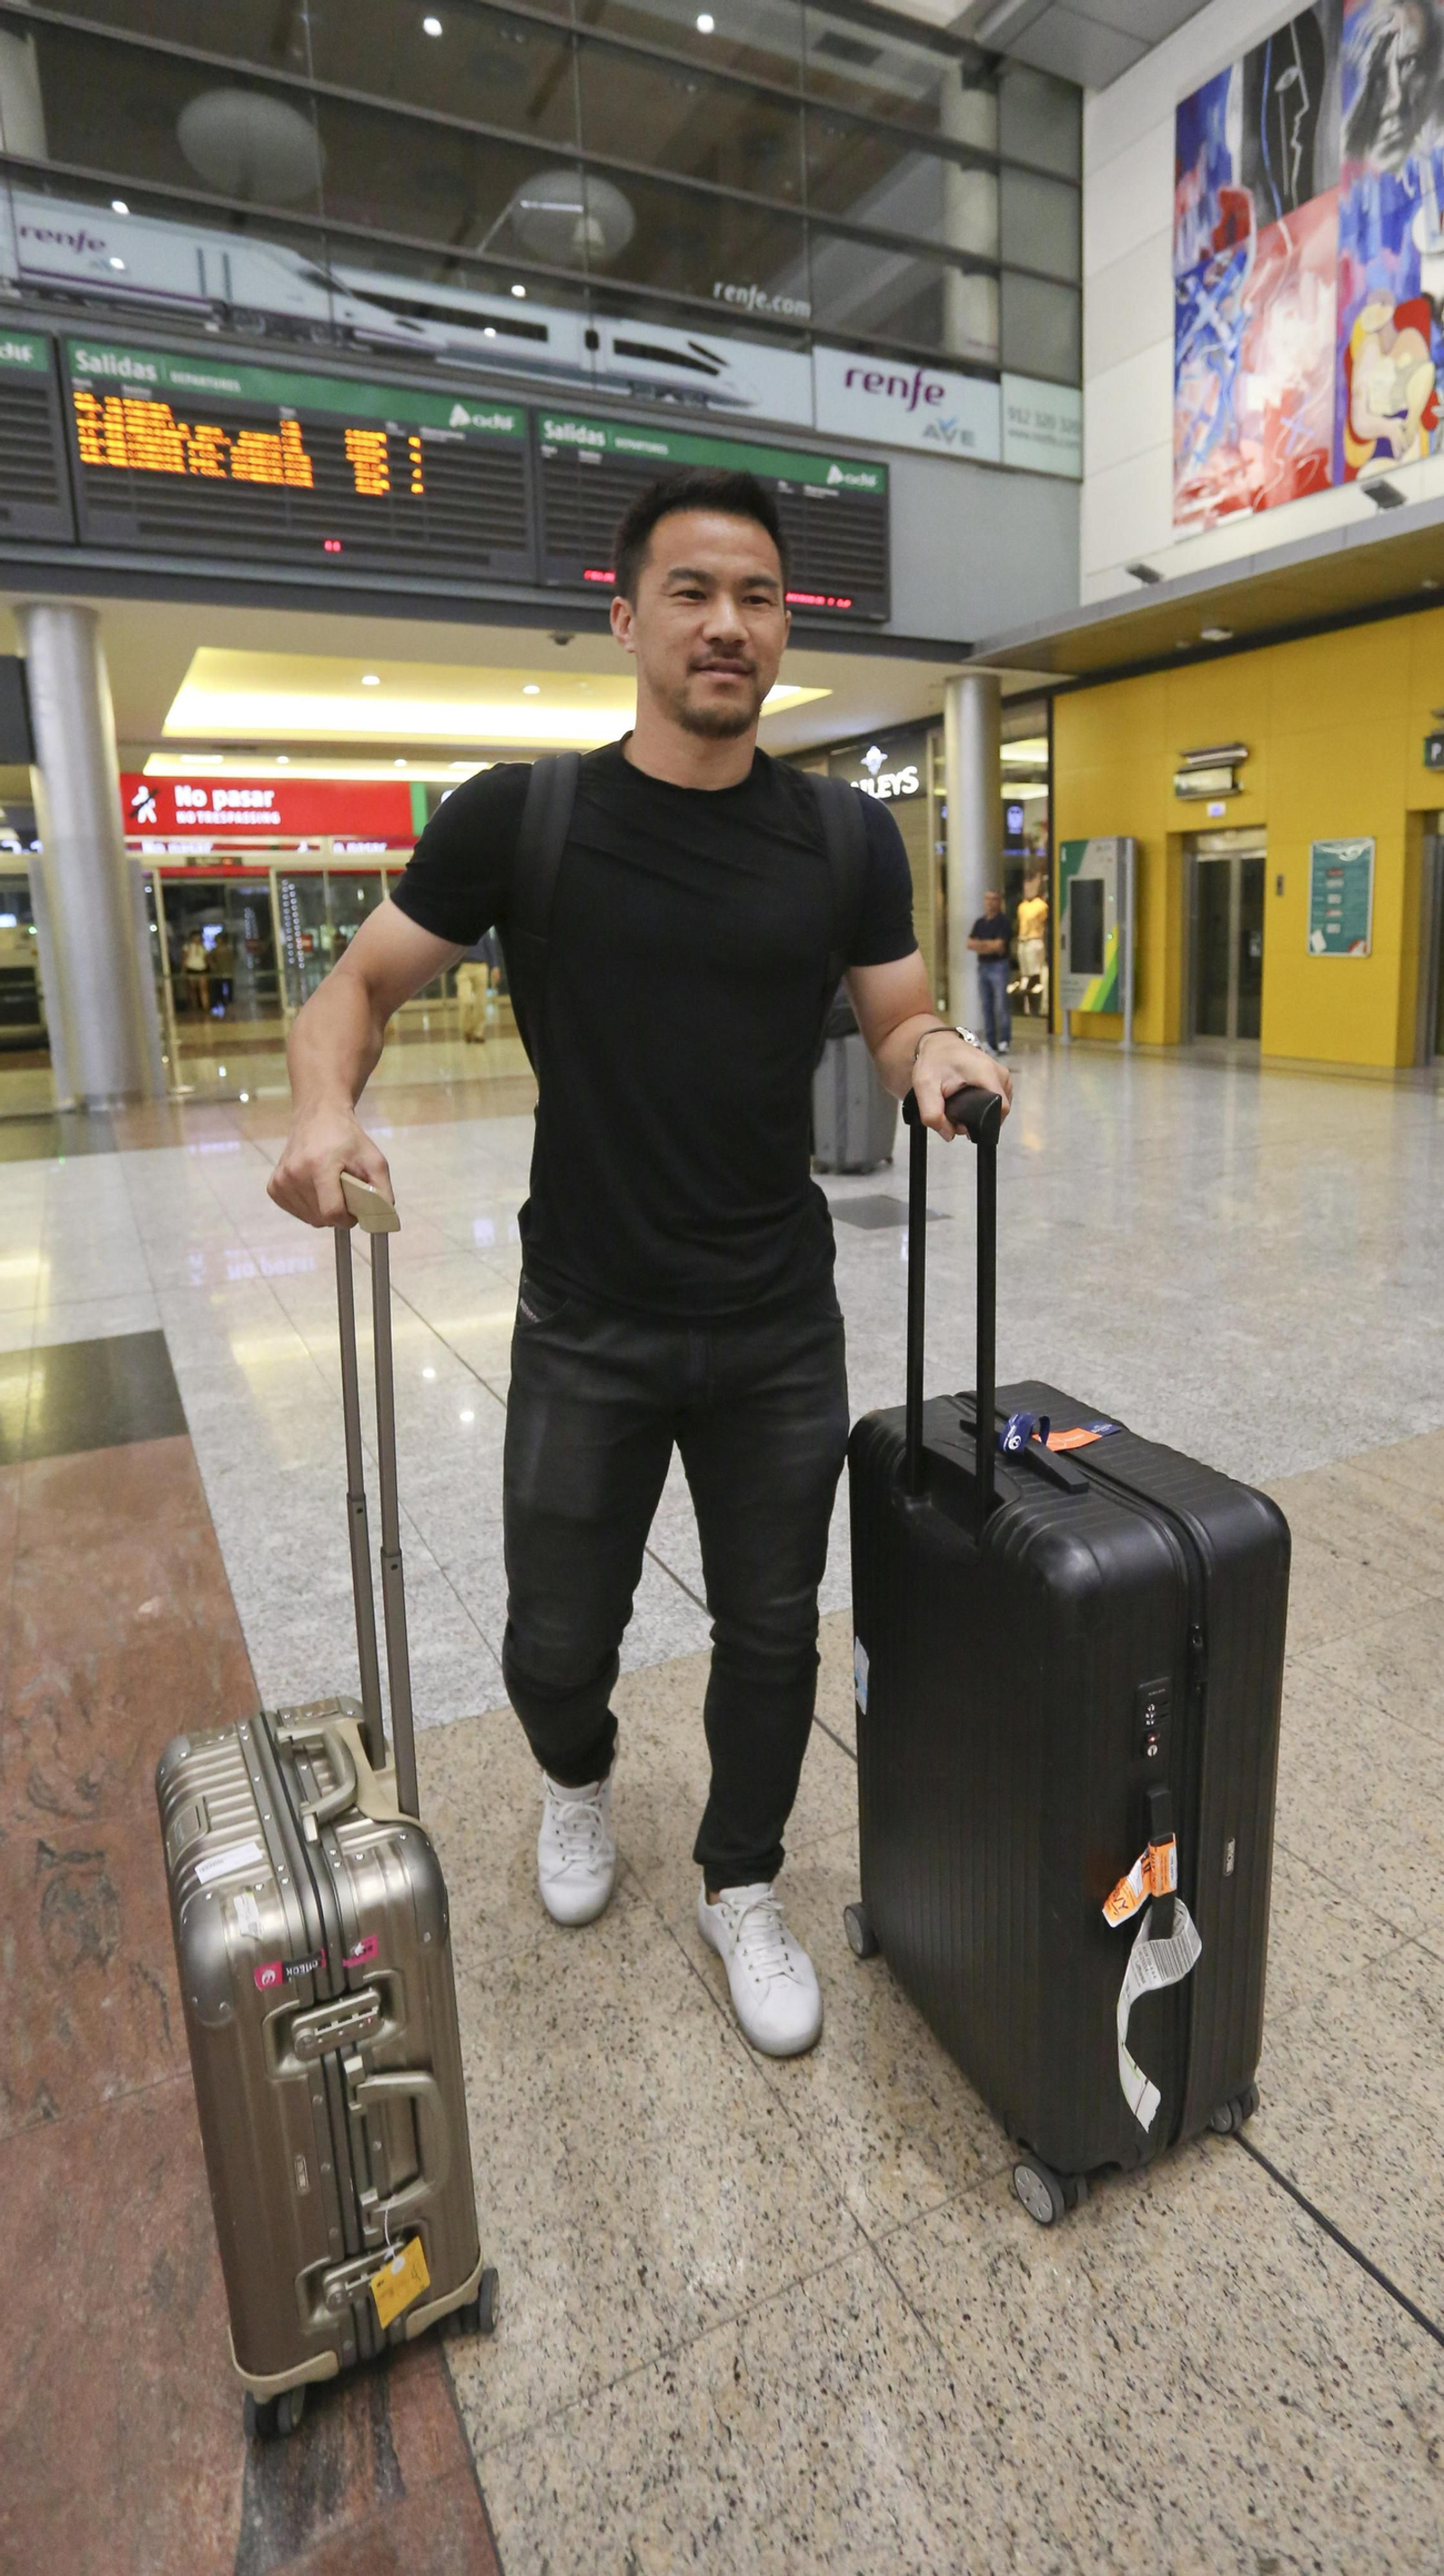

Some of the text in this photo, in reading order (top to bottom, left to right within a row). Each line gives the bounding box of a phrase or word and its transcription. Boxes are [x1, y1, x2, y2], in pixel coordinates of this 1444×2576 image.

[20, 226, 106, 254] renfe
[713, 282, 811, 319] renfe.com
[74, 348, 158, 383] Salidas
[845, 367, 946, 412] renfe
[543, 420, 606, 448] Salidas
[921, 415, 977, 448] AVE
[174, 784, 275, 811] No pasar
[176, 810, 281, 826] NO TRESPASSING
